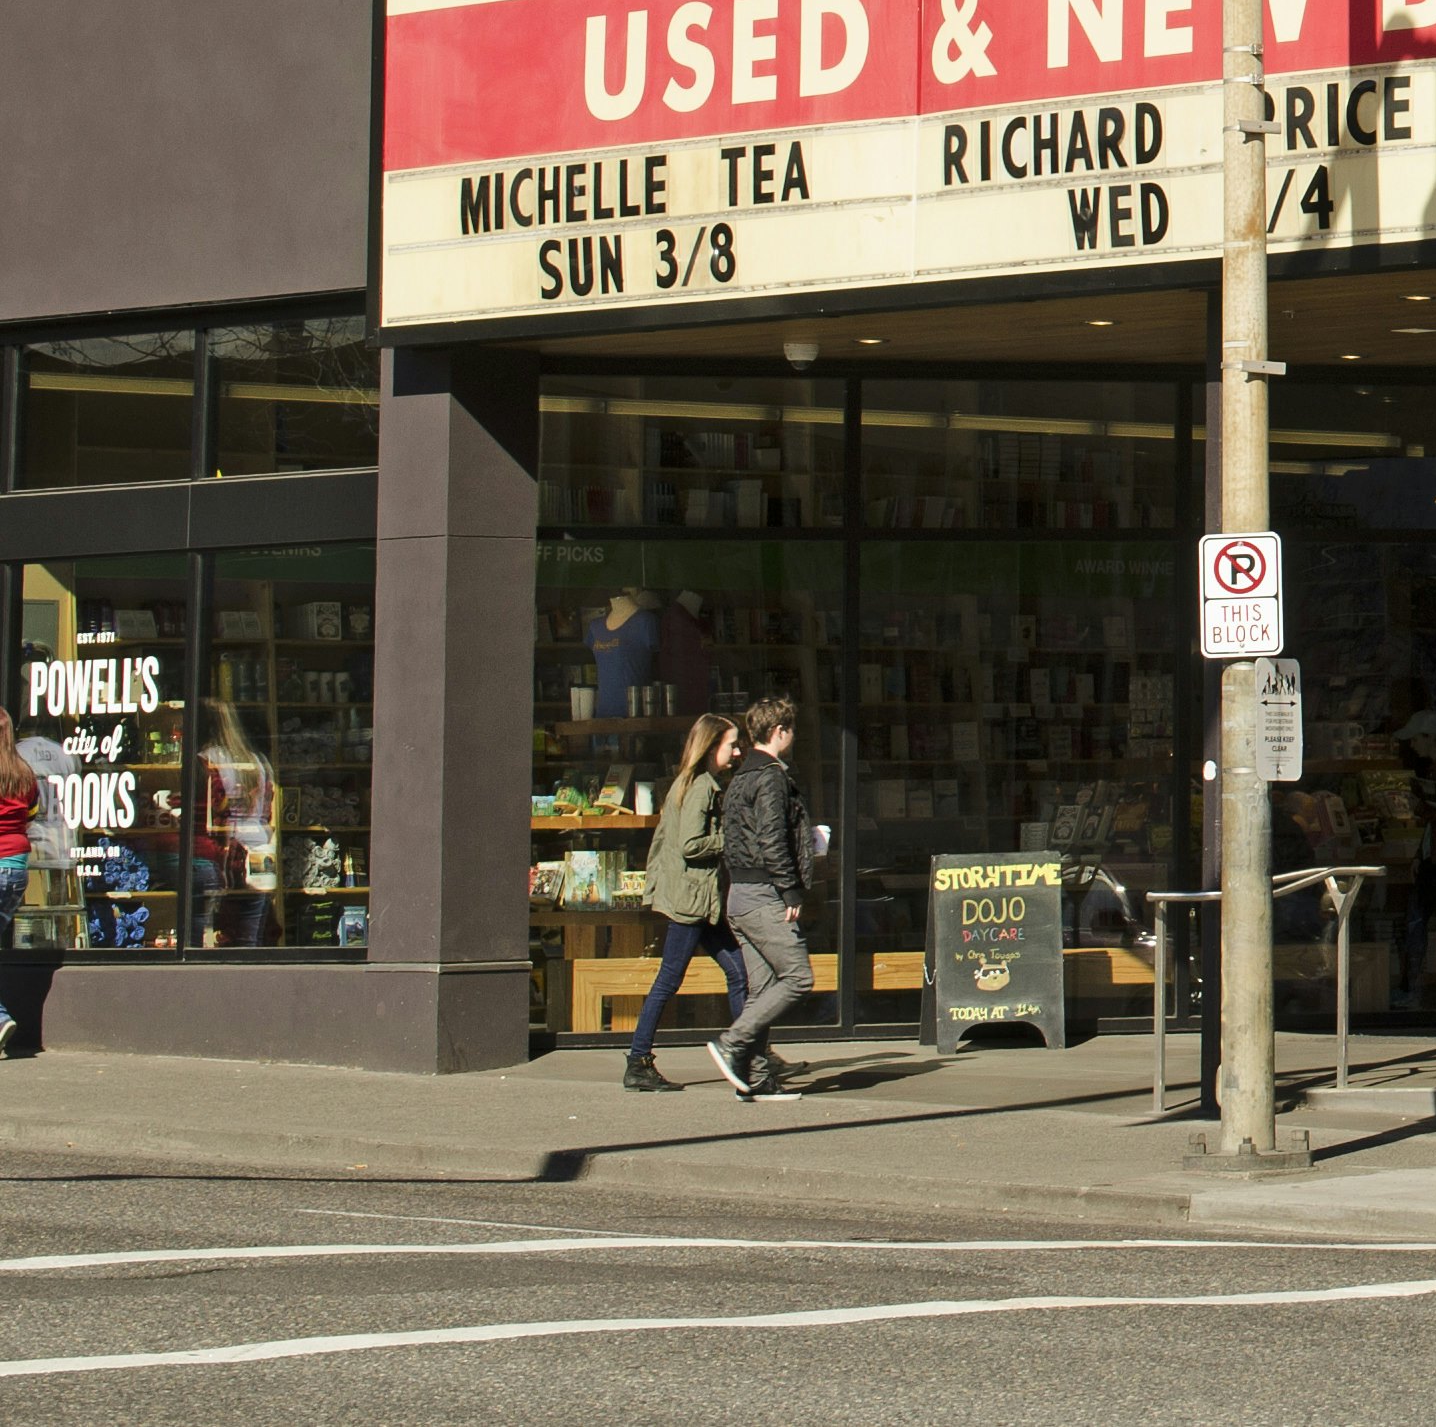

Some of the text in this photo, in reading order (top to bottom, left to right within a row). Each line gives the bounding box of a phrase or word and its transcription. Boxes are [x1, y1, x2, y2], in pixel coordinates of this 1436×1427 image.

[943, 102, 1163, 187] RICHARD
[460, 141, 810, 236] MICHELLE TEA
[1067, 165, 1334, 251] WED /4
[538, 222, 737, 301] SUN 3/8
[556, 545, 605, 563] PICKS
[1074, 559, 1176, 575] AWARD WINNE
[1221, 603, 1262, 624] THIS
[77, 631, 115, 644] EST. 1971
[1212, 624, 1271, 644] BLOCK
[30, 655, 159, 717] POWELL'S
[63, 724, 123, 763] city of
[47, 771, 136, 830] BOOKS
[70, 845, 120, 860] RTLAND, OR
[77, 864, 102, 876] U.S.A.
[934, 863, 1063, 891] STORYTIME
[962, 896, 1026, 925] DOJO
[962, 927, 1025, 943] DAYCARE
[949, 1006, 988, 1021] TODAY
[990, 1005, 1010, 1019] AT
